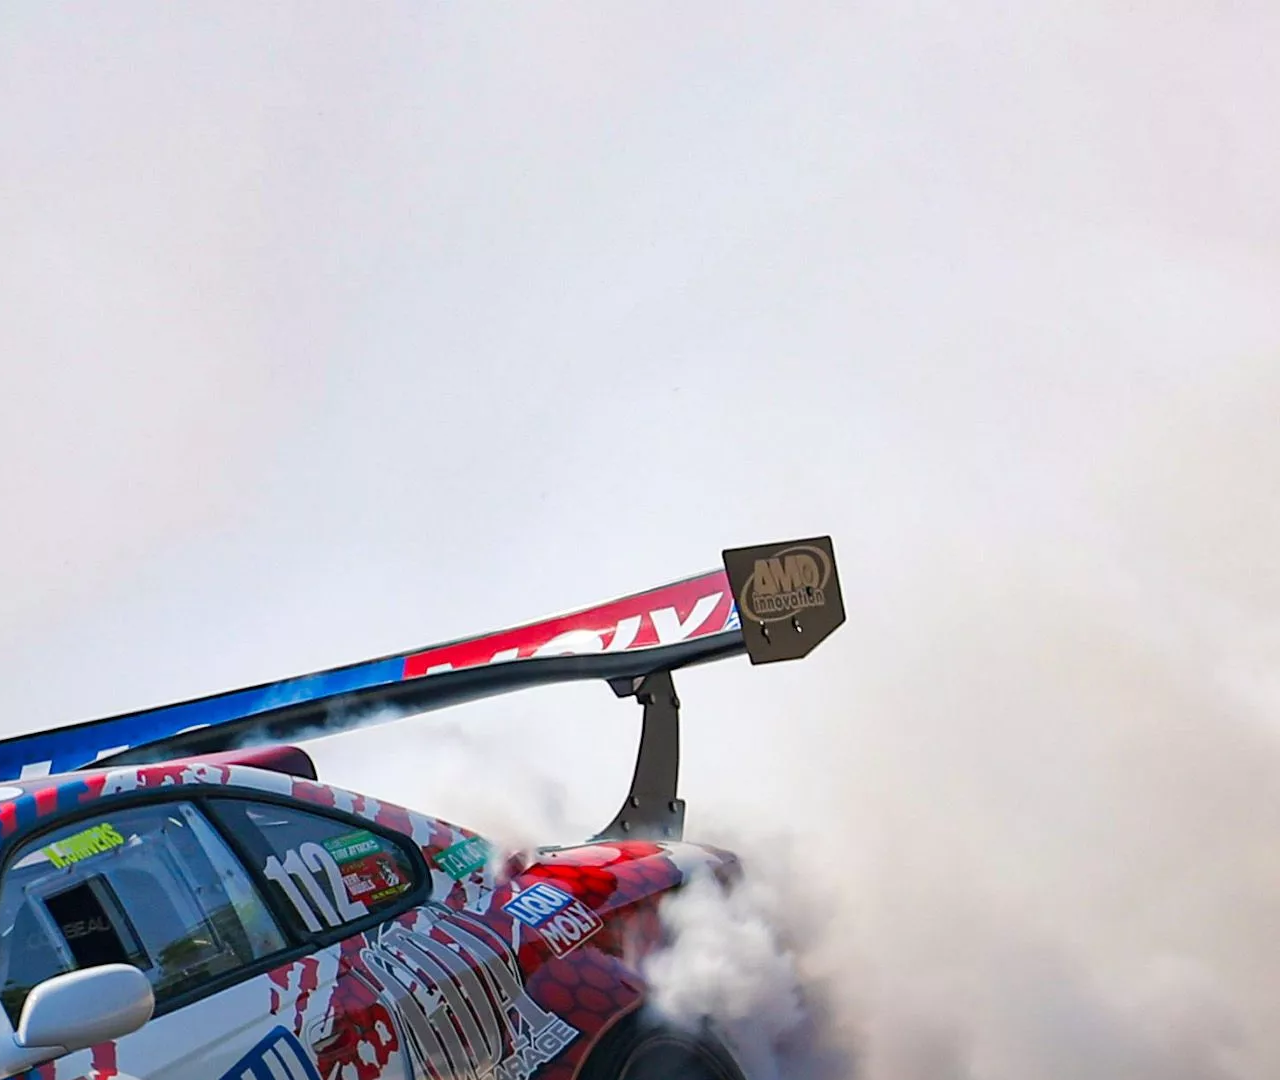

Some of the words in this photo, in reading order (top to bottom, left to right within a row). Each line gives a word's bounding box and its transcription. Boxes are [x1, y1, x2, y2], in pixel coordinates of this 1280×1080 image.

[264, 842, 369, 932] 112
[506, 885, 569, 925] LIQUI
[540, 902, 597, 953] MOLY
